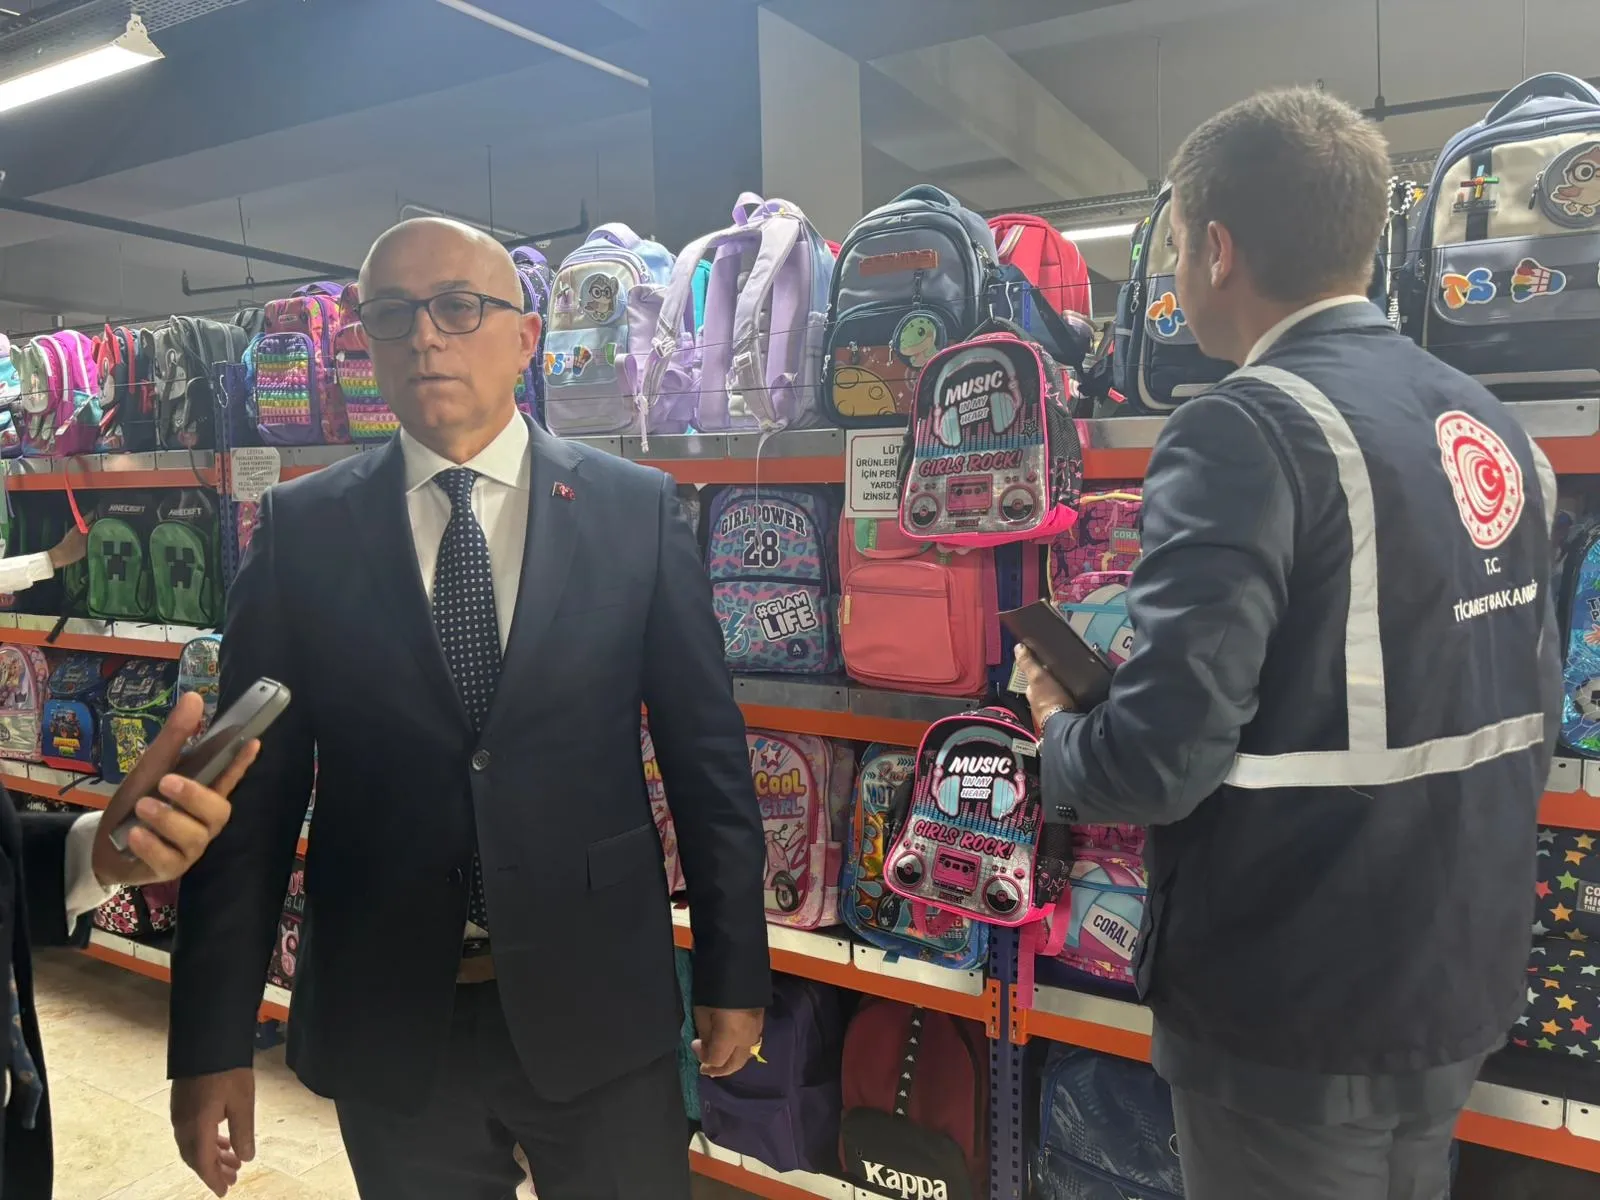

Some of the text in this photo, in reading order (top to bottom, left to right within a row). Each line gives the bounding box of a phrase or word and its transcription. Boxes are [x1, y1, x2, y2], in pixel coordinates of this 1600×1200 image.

[944, 370, 1004, 407] MUSIC
[959, 395, 989, 415] IN MY
[960, 408, 990, 426] HEART
[880, 470, 896, 478] PER
[919, 450, 1023, 478] GIRLS ROCK!
[720, 504, 806, 537] GIRL POWER
[743, 528, 781, 569] 28
[756, 592, 810, 619] #GLAM
[1453, 597, 1489, 622] TİCARET
[761, 605, 817, 640] LIFE
[948, 756, 1013, 774] MUSIC
[960, 788, 991, 800] HEART
[962, 776, 993, 787] IN MY
[914, 820, 1016, 860] GIRLS ROCK!
[1093, 914, 1130, 948] CORAL
[861, 1159, 948, 1200] Kappa
